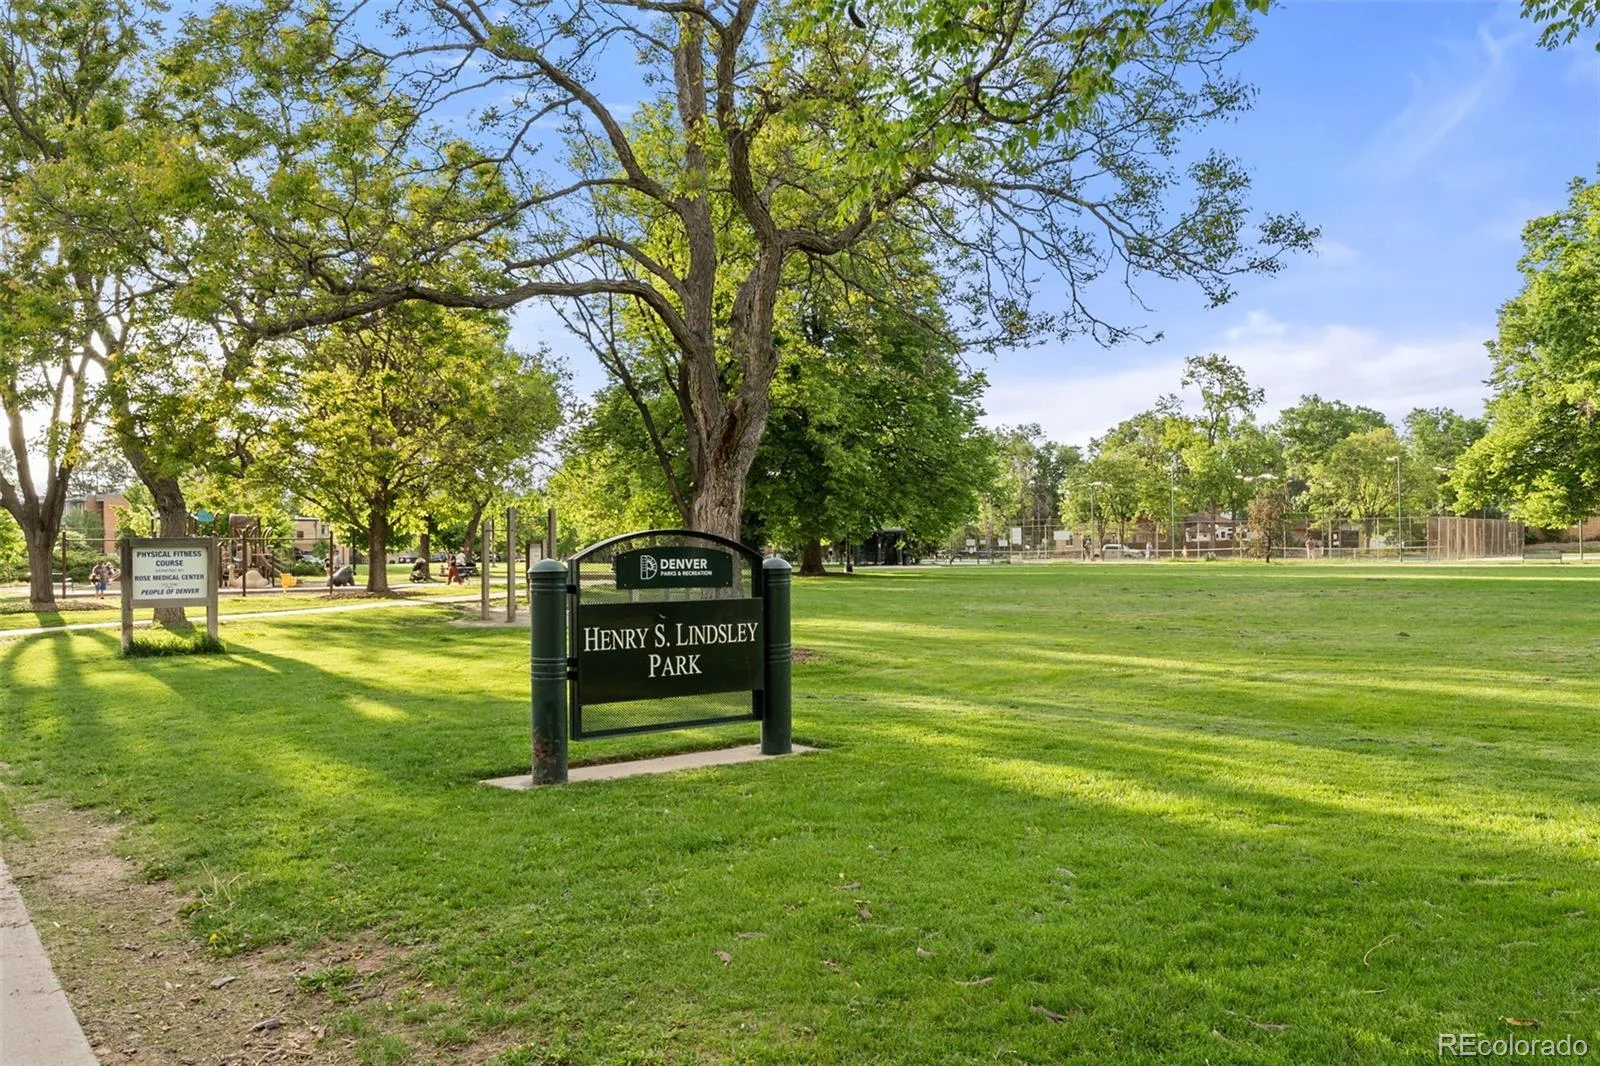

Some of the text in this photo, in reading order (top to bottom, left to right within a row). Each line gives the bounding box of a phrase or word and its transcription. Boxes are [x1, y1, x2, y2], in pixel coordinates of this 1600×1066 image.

[136, 550, 202, 558] PHYSICAL FITNESS
[660, 558, 708, 569] DENVER
[140, 588, 165, 596] PEOPLE
[583, 622, 759, 652] HENRY S. LINDSLEY
[648, 653, 703, 678] PARK
